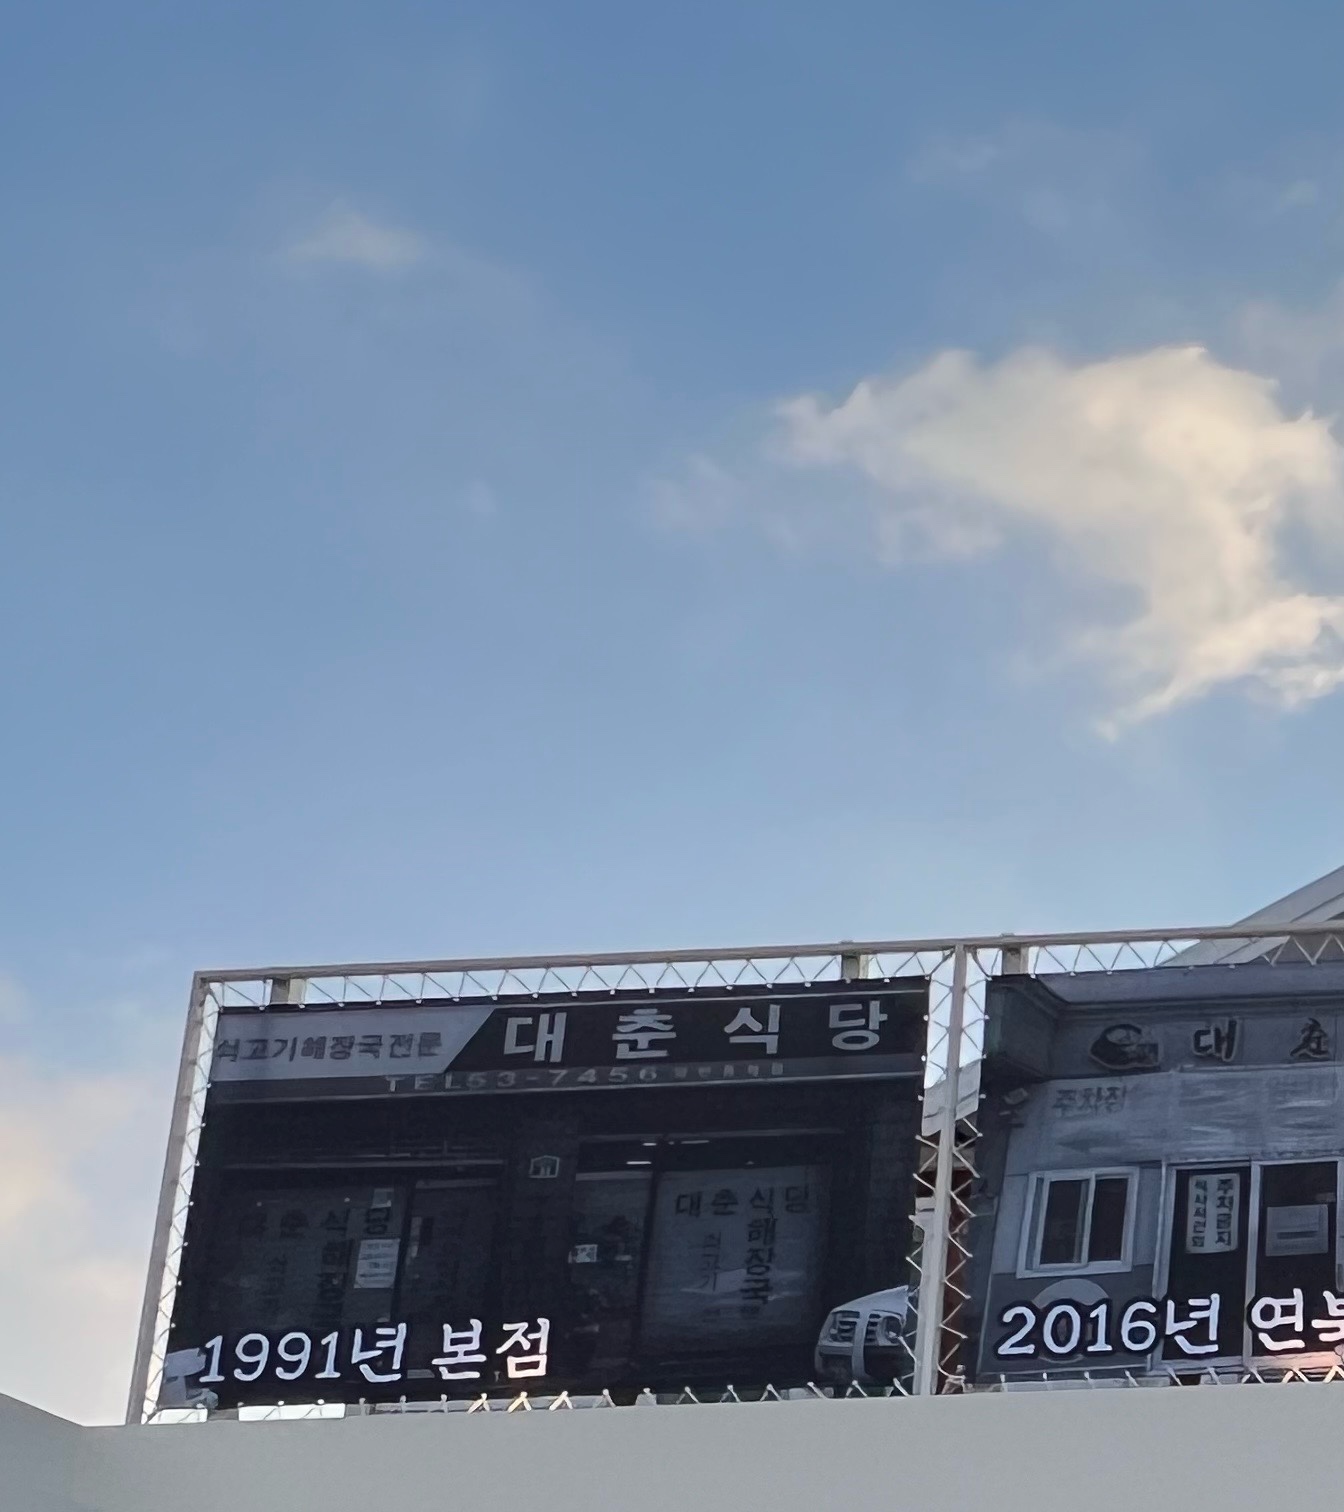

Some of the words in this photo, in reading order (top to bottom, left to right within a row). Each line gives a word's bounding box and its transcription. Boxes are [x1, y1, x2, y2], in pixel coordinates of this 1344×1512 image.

[503, 1000, 888, 1063] 대춘식당
[199, 1322, 407, 1383] 1991년
[430, 1317, 551, 1380] 본점
[999, 1292, 1222, 1359] 2016년
